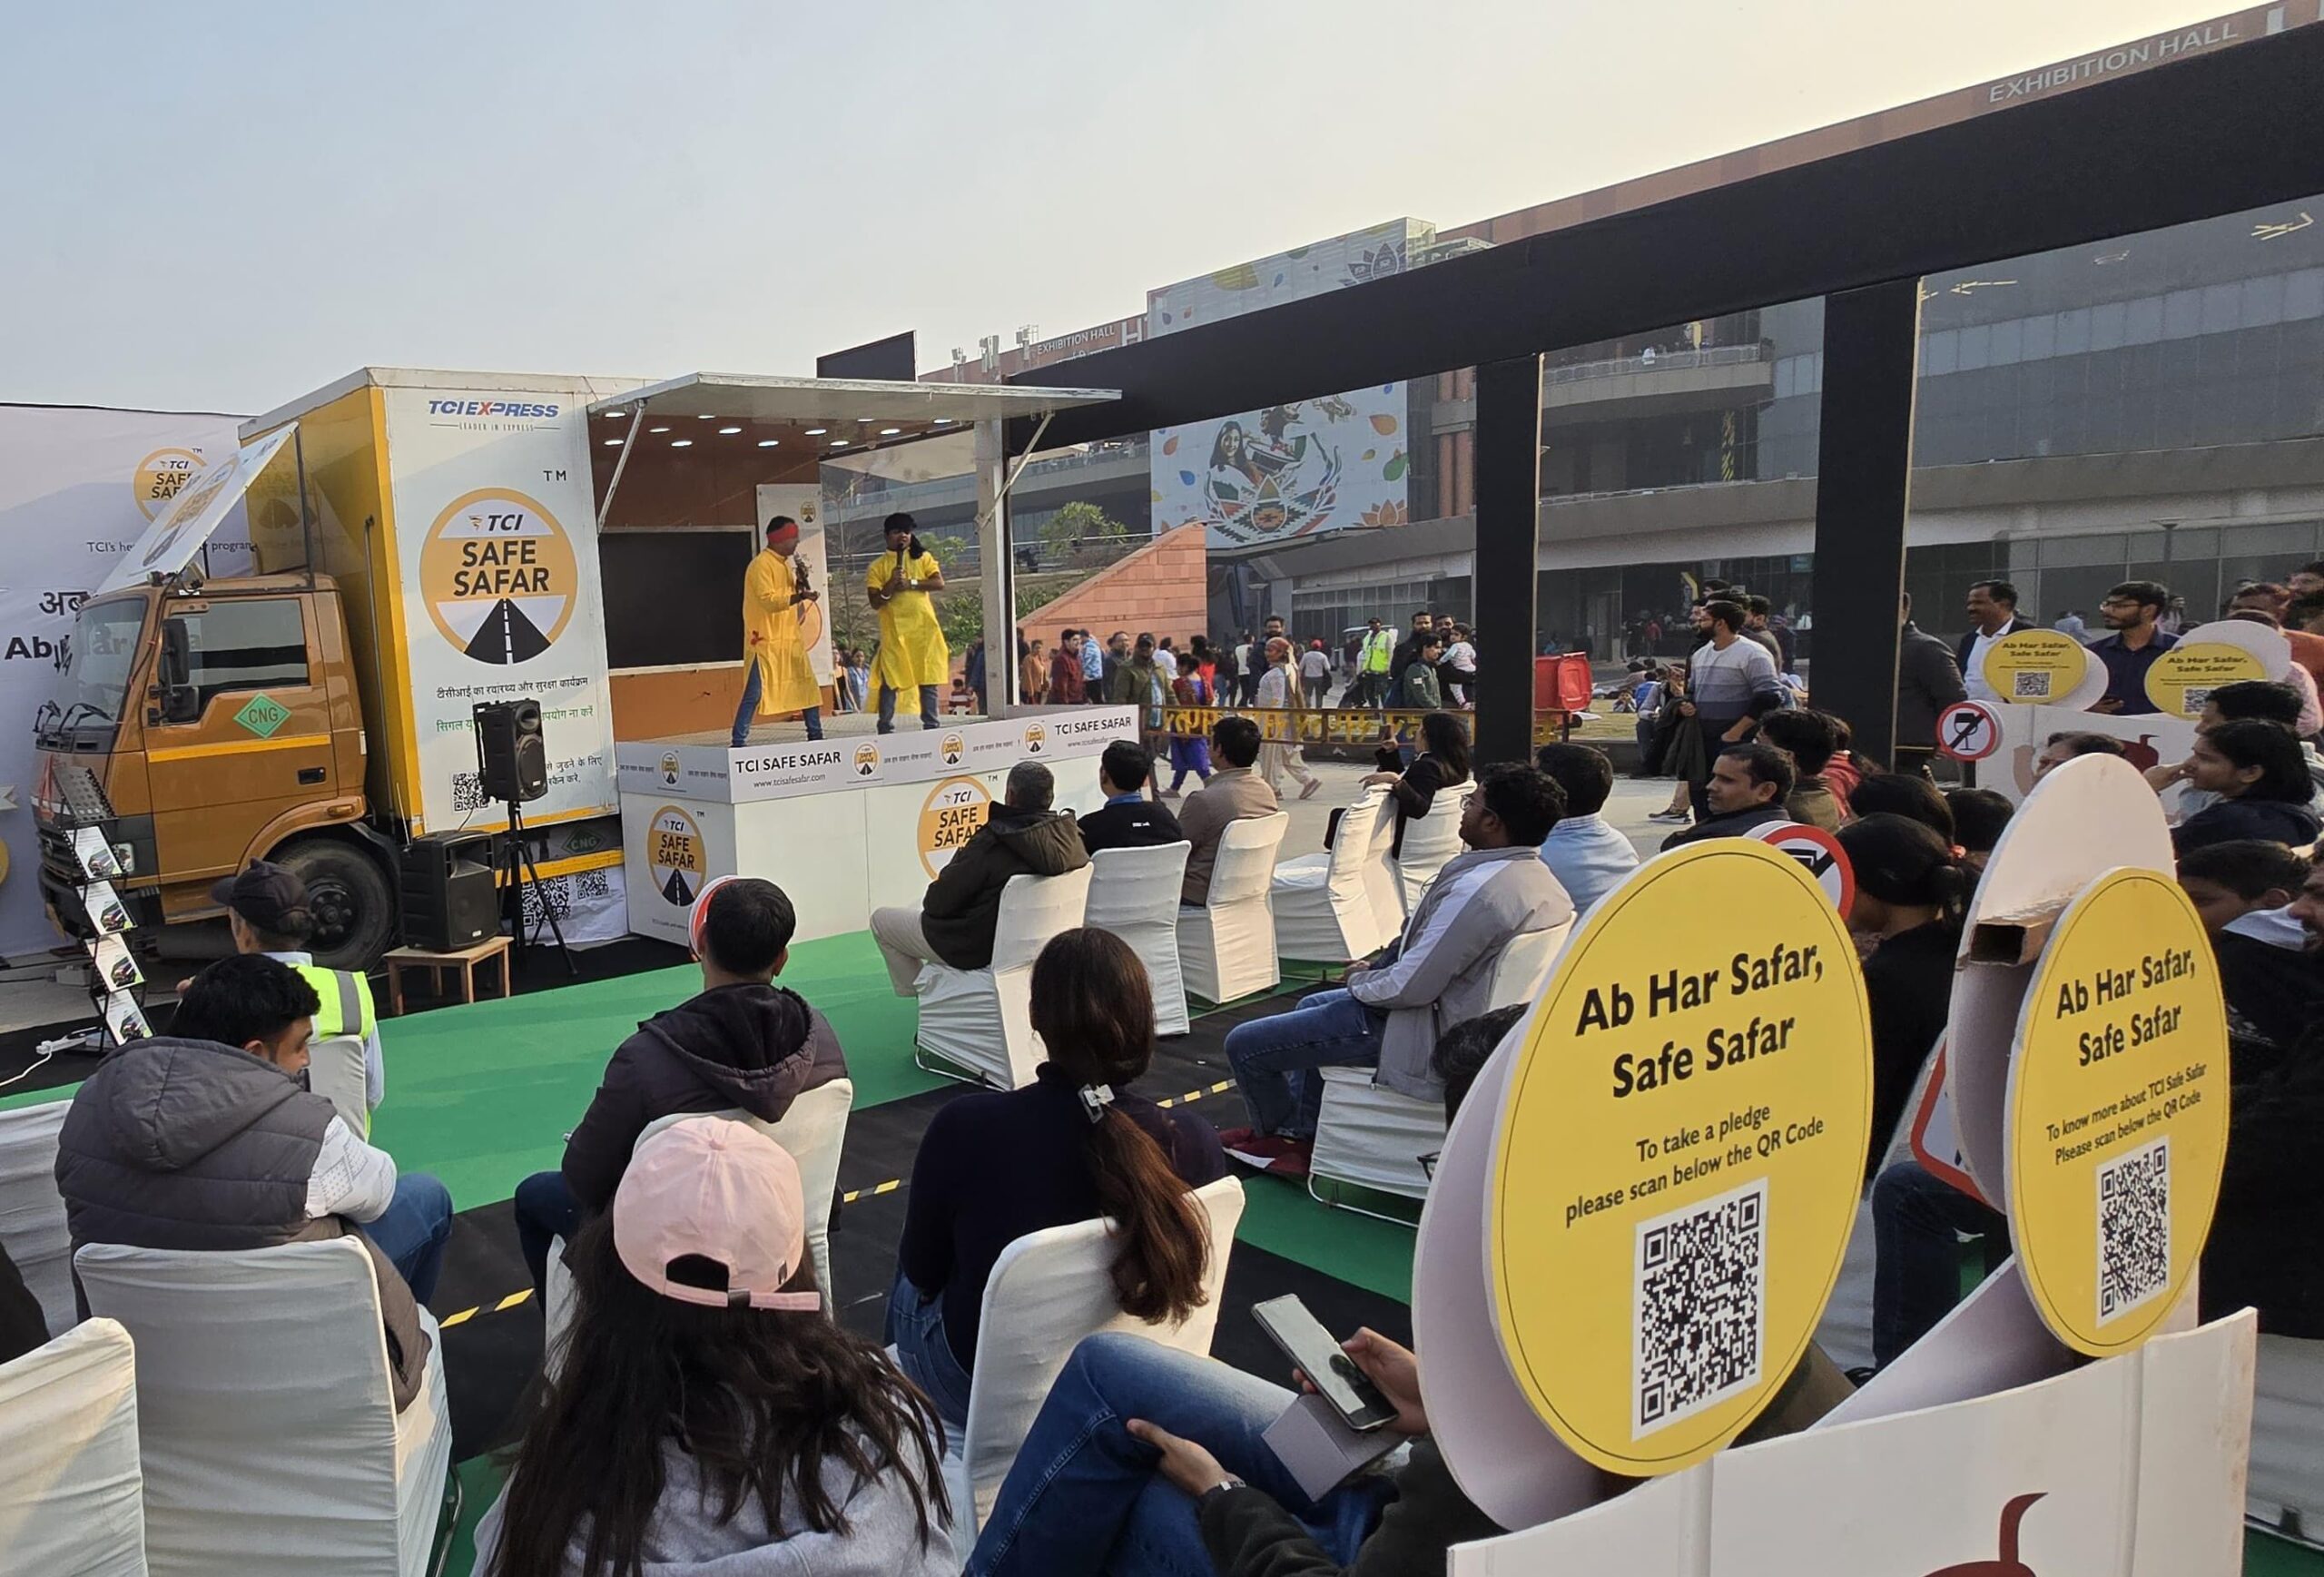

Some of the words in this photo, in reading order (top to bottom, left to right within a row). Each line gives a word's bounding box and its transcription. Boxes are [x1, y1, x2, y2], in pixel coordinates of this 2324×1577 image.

[1989, 45, 2149, 103] EXHIBITION
[2158, 23, 2238, 57] HALL
[1038, 332, 1088, 354] EXHIBITION
[1090, 325, 1115, 340] HALL
[459, 422, 487, 430] LEADER
[503, 423, 534, 431] EXPRESS
[170, 460, 189, 469] TCI
[152, 486, 181, 498] SAF
[487, 514, 524, 531] TCI
[86, 542, 116, 552] TCI's
[462, 540, 536, 567] SAFE
[453, 567, 549, 596] SAFAR
[5, 636, 53, 660] Ab
[473, 687, 484, 695] का
[518, 680, 534, 691] और
[535, 680, 557, 693] सुरक्षा
[248, 707, 279, 724] CNG
[569, 709, 578, 718] ना
[1054, 724, 1072, 735] TCI
[1074, 720, 1099, 734] SAFE
[1101, 716, 1132, 730] SAFAR
[735, 760, 759, 774] TCI
[763, 755, 796, 771] SAFE
[800, 751, 842, 766] SAFAR
[753, 774, 826, 788] www.tcisafesafar.com
[953, 791, 971, 803] TCI
[670, 820, 684, 832] TCI
[940, 807, 978, 828] SAFE
[572, 836, 596, 850] CNG
[661, 833, 690, 852] SAFE
[658, 849, 695, 869] SAFAR
[1575, 983, 1634, 1037] Ab
[1649, 969, 1719, 1019] Har
[1730, 943, 1823, 996] Safar,
[2056, 980, 2088, 1020] Ab
[2095, 968, 2136, 1006] Har
[2142, 948, 2195, 989] Safar,
[2079, 1023, 2124, 1067] Safe
[2131, 1004, 2181, 1047] Safar
[1613, 1041, 1693, 1099] Safe
[1706, 1017, 1796, 1071] Safar
[2046, 1124, 2060, 1141] To
[2063, 1114, 2089, 1136] know
[2092, 1103, 2118, 1123] more
[2120, 1092, 2146, 1112] about
[2148, 1079, 2164, 1099] TCI
[2166, 1071, 2183, 1091] Safe
[2186, 1062, 2207, 1082] Safar
[1636, 1139, 1658, 1162] To
[1663, 1128, 1700, 1154] take
[1705, 1125, 1714, 1139] a
[1719, 1105, 1770, 1142] pledge
[2055, 1139, 2092, 1165] Plsease
[2094, 1129, 2115, 1149] scan
[2118, 1117, 2144, 1138] below
[2147, 1108, 2162, 1125] the
[2163, 1098, 2178, 1117] QR
[2179, 1089, 2201, 1110] Code
[1566, 1188, 1624, 1228] please
[1630, 1174, 1667, 1200] scan
[1673, 1154, 1721, 1187] below
[1727, 1144, 1752, 1167] the
[1757, 1130, 1781, 1158] QR
[1786, 1117, 1824, 1145] Code
